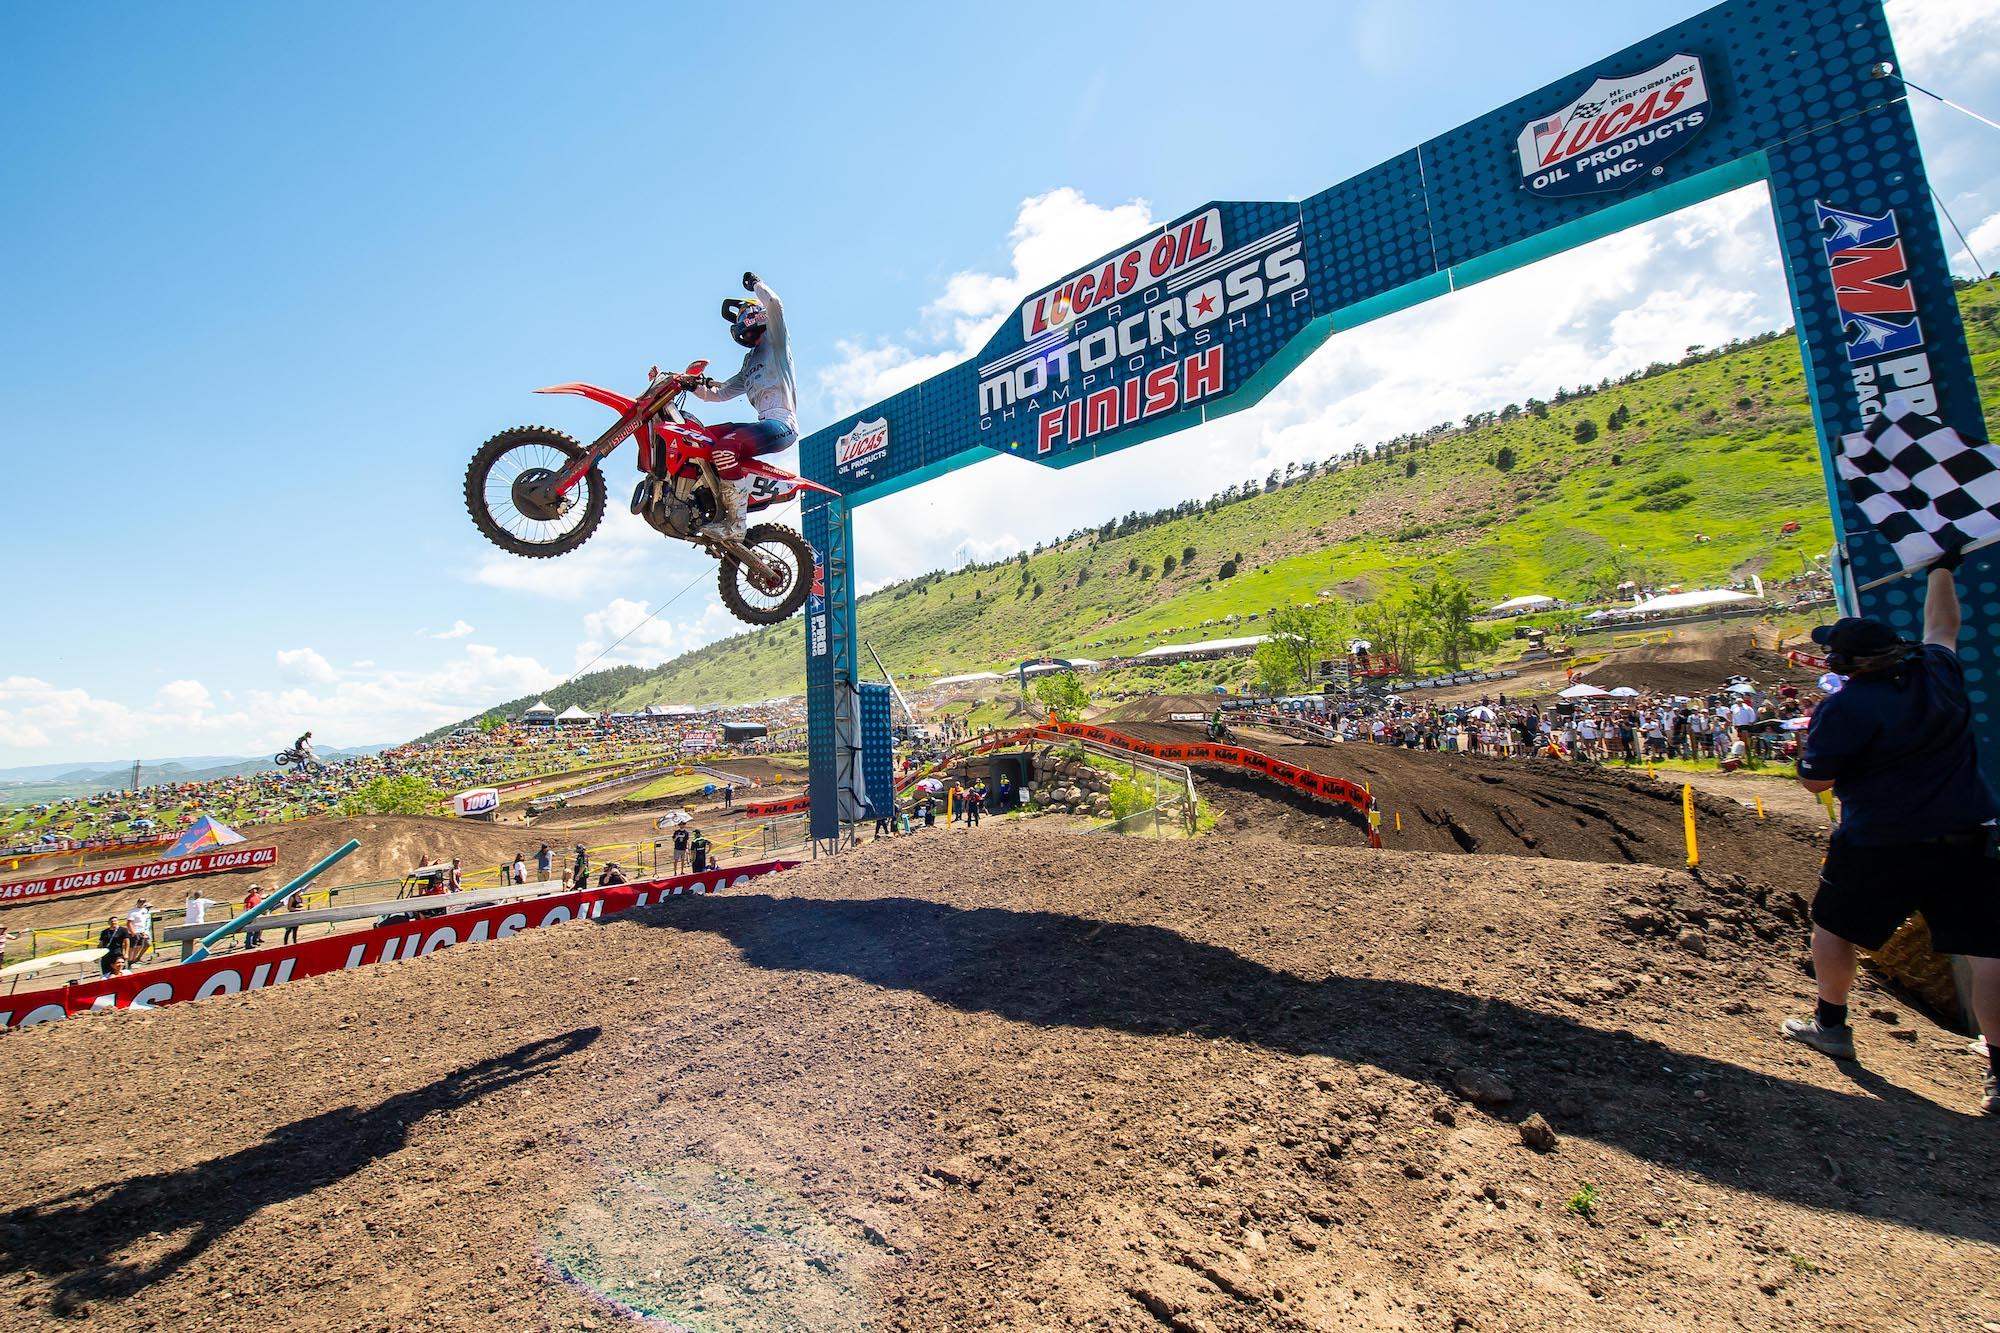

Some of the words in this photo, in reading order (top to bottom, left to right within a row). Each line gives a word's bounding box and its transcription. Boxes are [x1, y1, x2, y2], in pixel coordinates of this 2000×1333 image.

[1610, 64, 1696, 106] PERFORMANCE
[1539, 76, 1694, 167] LUCAS
[1532, 168, 1570, 190] OIL
[1576, 111, 1705, 172] PRODUCTS
[1596, 158, 1644, 184] INC.
[1031, 250, 1142, 336] LUCAS
[1149, 217, 1217, 278] OIL
[978, 241, 1307, 417] MOTOCROSS
[1075, 286, 1160, 336] PRO
[1814, 199, 1925, 362] AMA
[1878, 352, 1942, 424] PR
[980, 288, 1309, 431] CHAMPIONSHIP
[1038, 343, 1224, 455] FINISH
[1850, 364, 1882, 431] RACI
[838, 467, 850, 475] OIL
[851, 449, 887, 470] PRODUCTS
[841, 429, 887, 462] LUCAS
[751, 476, 779, 496] 94
[816, 614, 827, 656] PRO
[466, 792, 496, 811] 100%
[0, 884, 22, 899] AS
[25, 881, 47, 895] OIL
[54, 872, 102, 891] LUCAS
[104, 869, 127, 882] OIL
[132, 861, 178, 880] LUCAS
[180, 859, 203, 872] OIL
[208, 852, 250, 868] LUCAS
[253, 849, 273, 863] OIL
